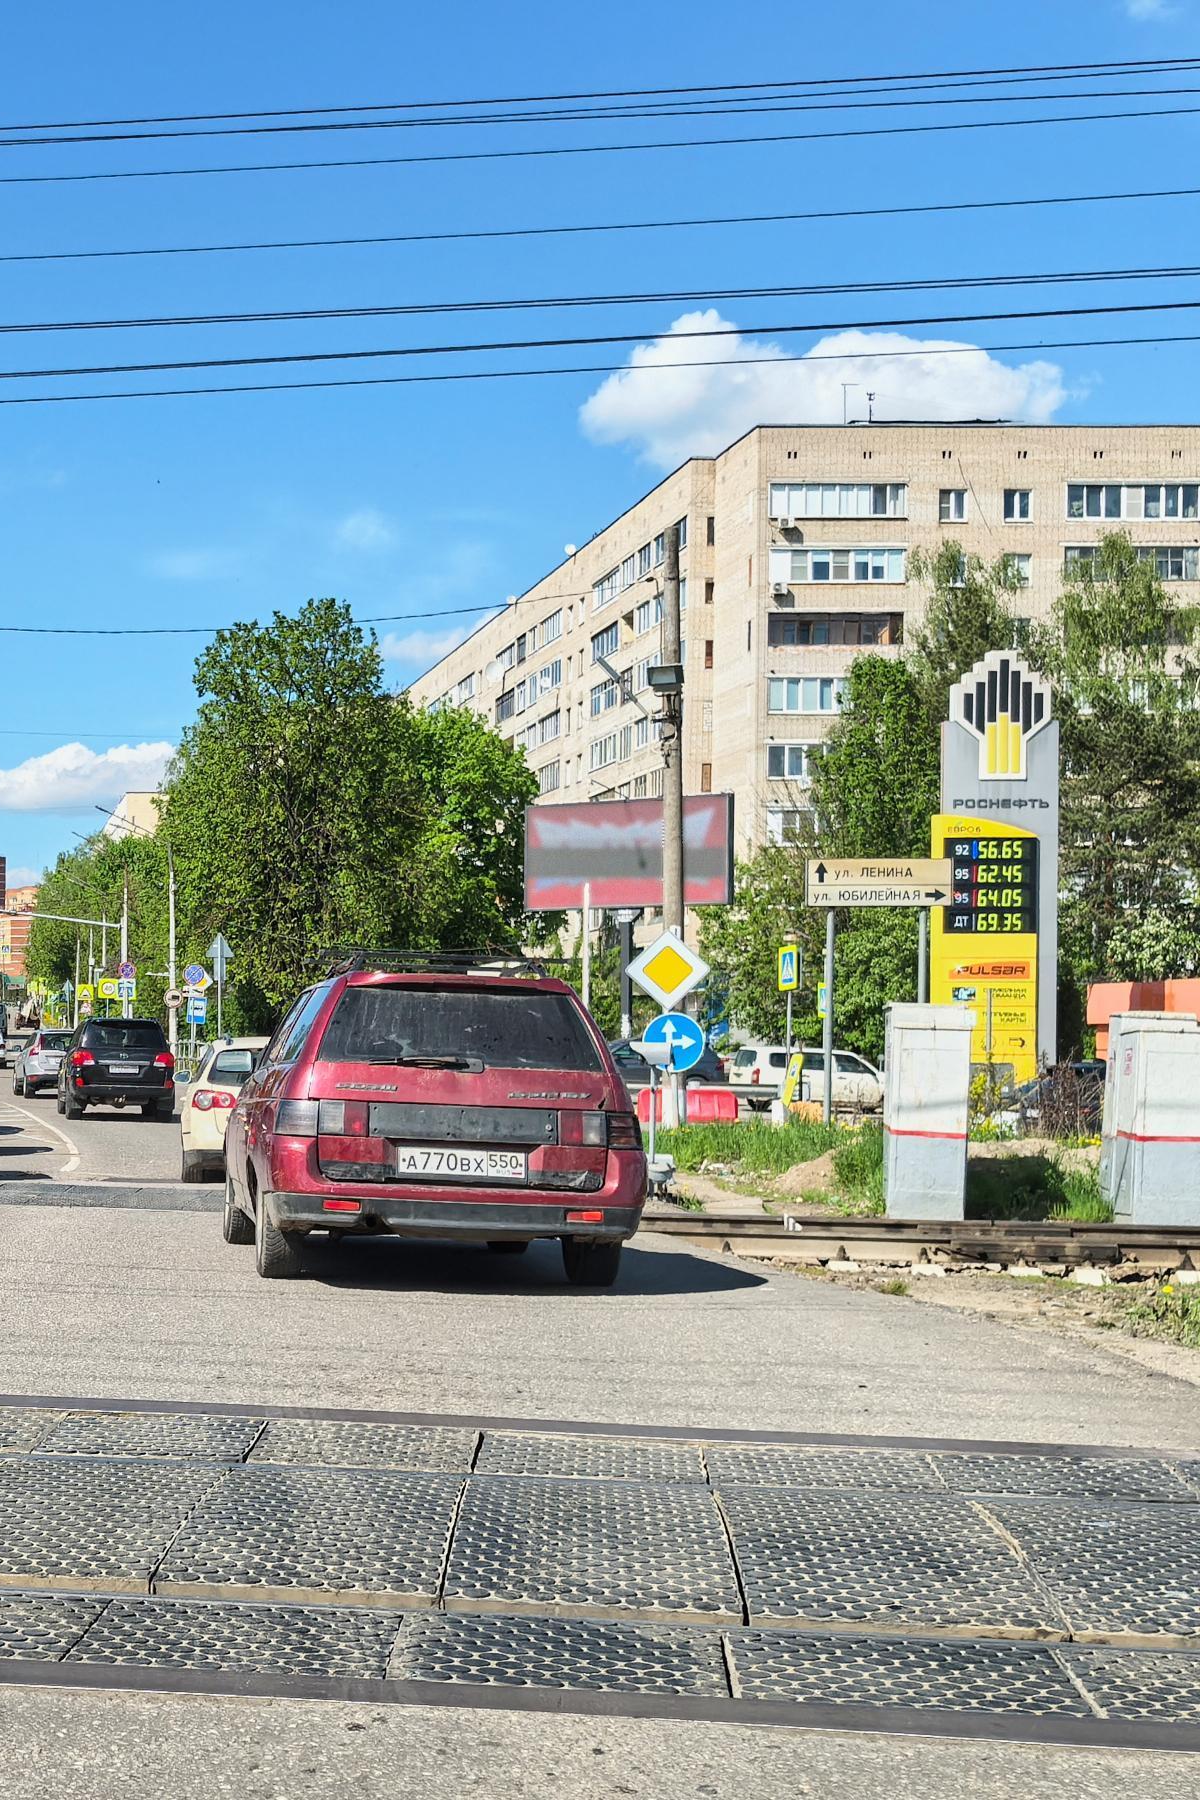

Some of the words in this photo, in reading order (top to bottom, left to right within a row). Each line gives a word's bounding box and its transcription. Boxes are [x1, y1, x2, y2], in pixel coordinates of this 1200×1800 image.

[952, 798, 1050, 809] РОСНЕФТЬ
[955, 844, 970, 856] 92
[978, 840, 1023, 859] 56.65
[834, 869, 854, 880] ул.
[860, 867, 913, 878] ЛЕНИНА
[954, 868, 970, 880] 95
[977, 864, 1022, 883] 62.45
[813, 892, 832, 903] ул.
[839, 887, 921, 901] ЮБИЛЕЙНАЯ
[954, 892, 970, 904] 95
[977, 888, 1022, 907] 64.05
[953, 915, 969, 928] ДТ
[976, 912, 1022, 931] 69.35
[406, 1151, 485, 1173] А770ВХ
[488, 1153, 519, 1169] 550
